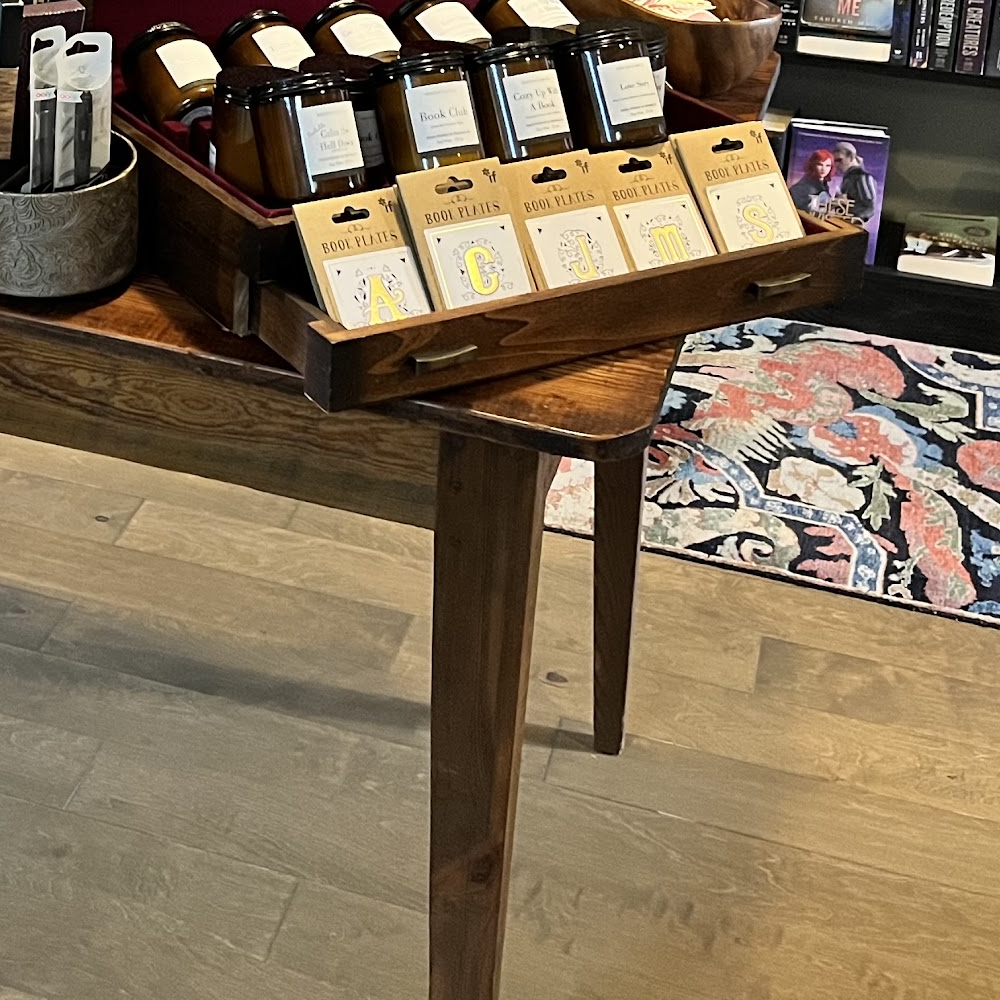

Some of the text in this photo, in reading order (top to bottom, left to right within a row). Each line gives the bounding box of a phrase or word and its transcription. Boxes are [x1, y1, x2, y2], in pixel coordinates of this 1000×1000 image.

[962, 7, 984, 58] CREATURES
[514, 88, 546, 103] Cozy Up
[538, 100, 556, 110] Book
[419, 107, 468, 122] Book Club
[320, 128, 338, 138] Calm
[320, 140, 336, 152] Hell
[704, 160, 770, 182] BOOK PLATES
[524, 190, 595, 214] BOOK PLATES
[612, 182, 680, 202] BOOK PLATES
[424, 200, 501, 225] BOOK PLATES
[742, 204, 774, 244] S
[321, 230, 398, 254] BOOK PLATES
[570, 234, 598, 280] J
[464, 246, 500, 296] C
[362, 274, 408, 327] A
